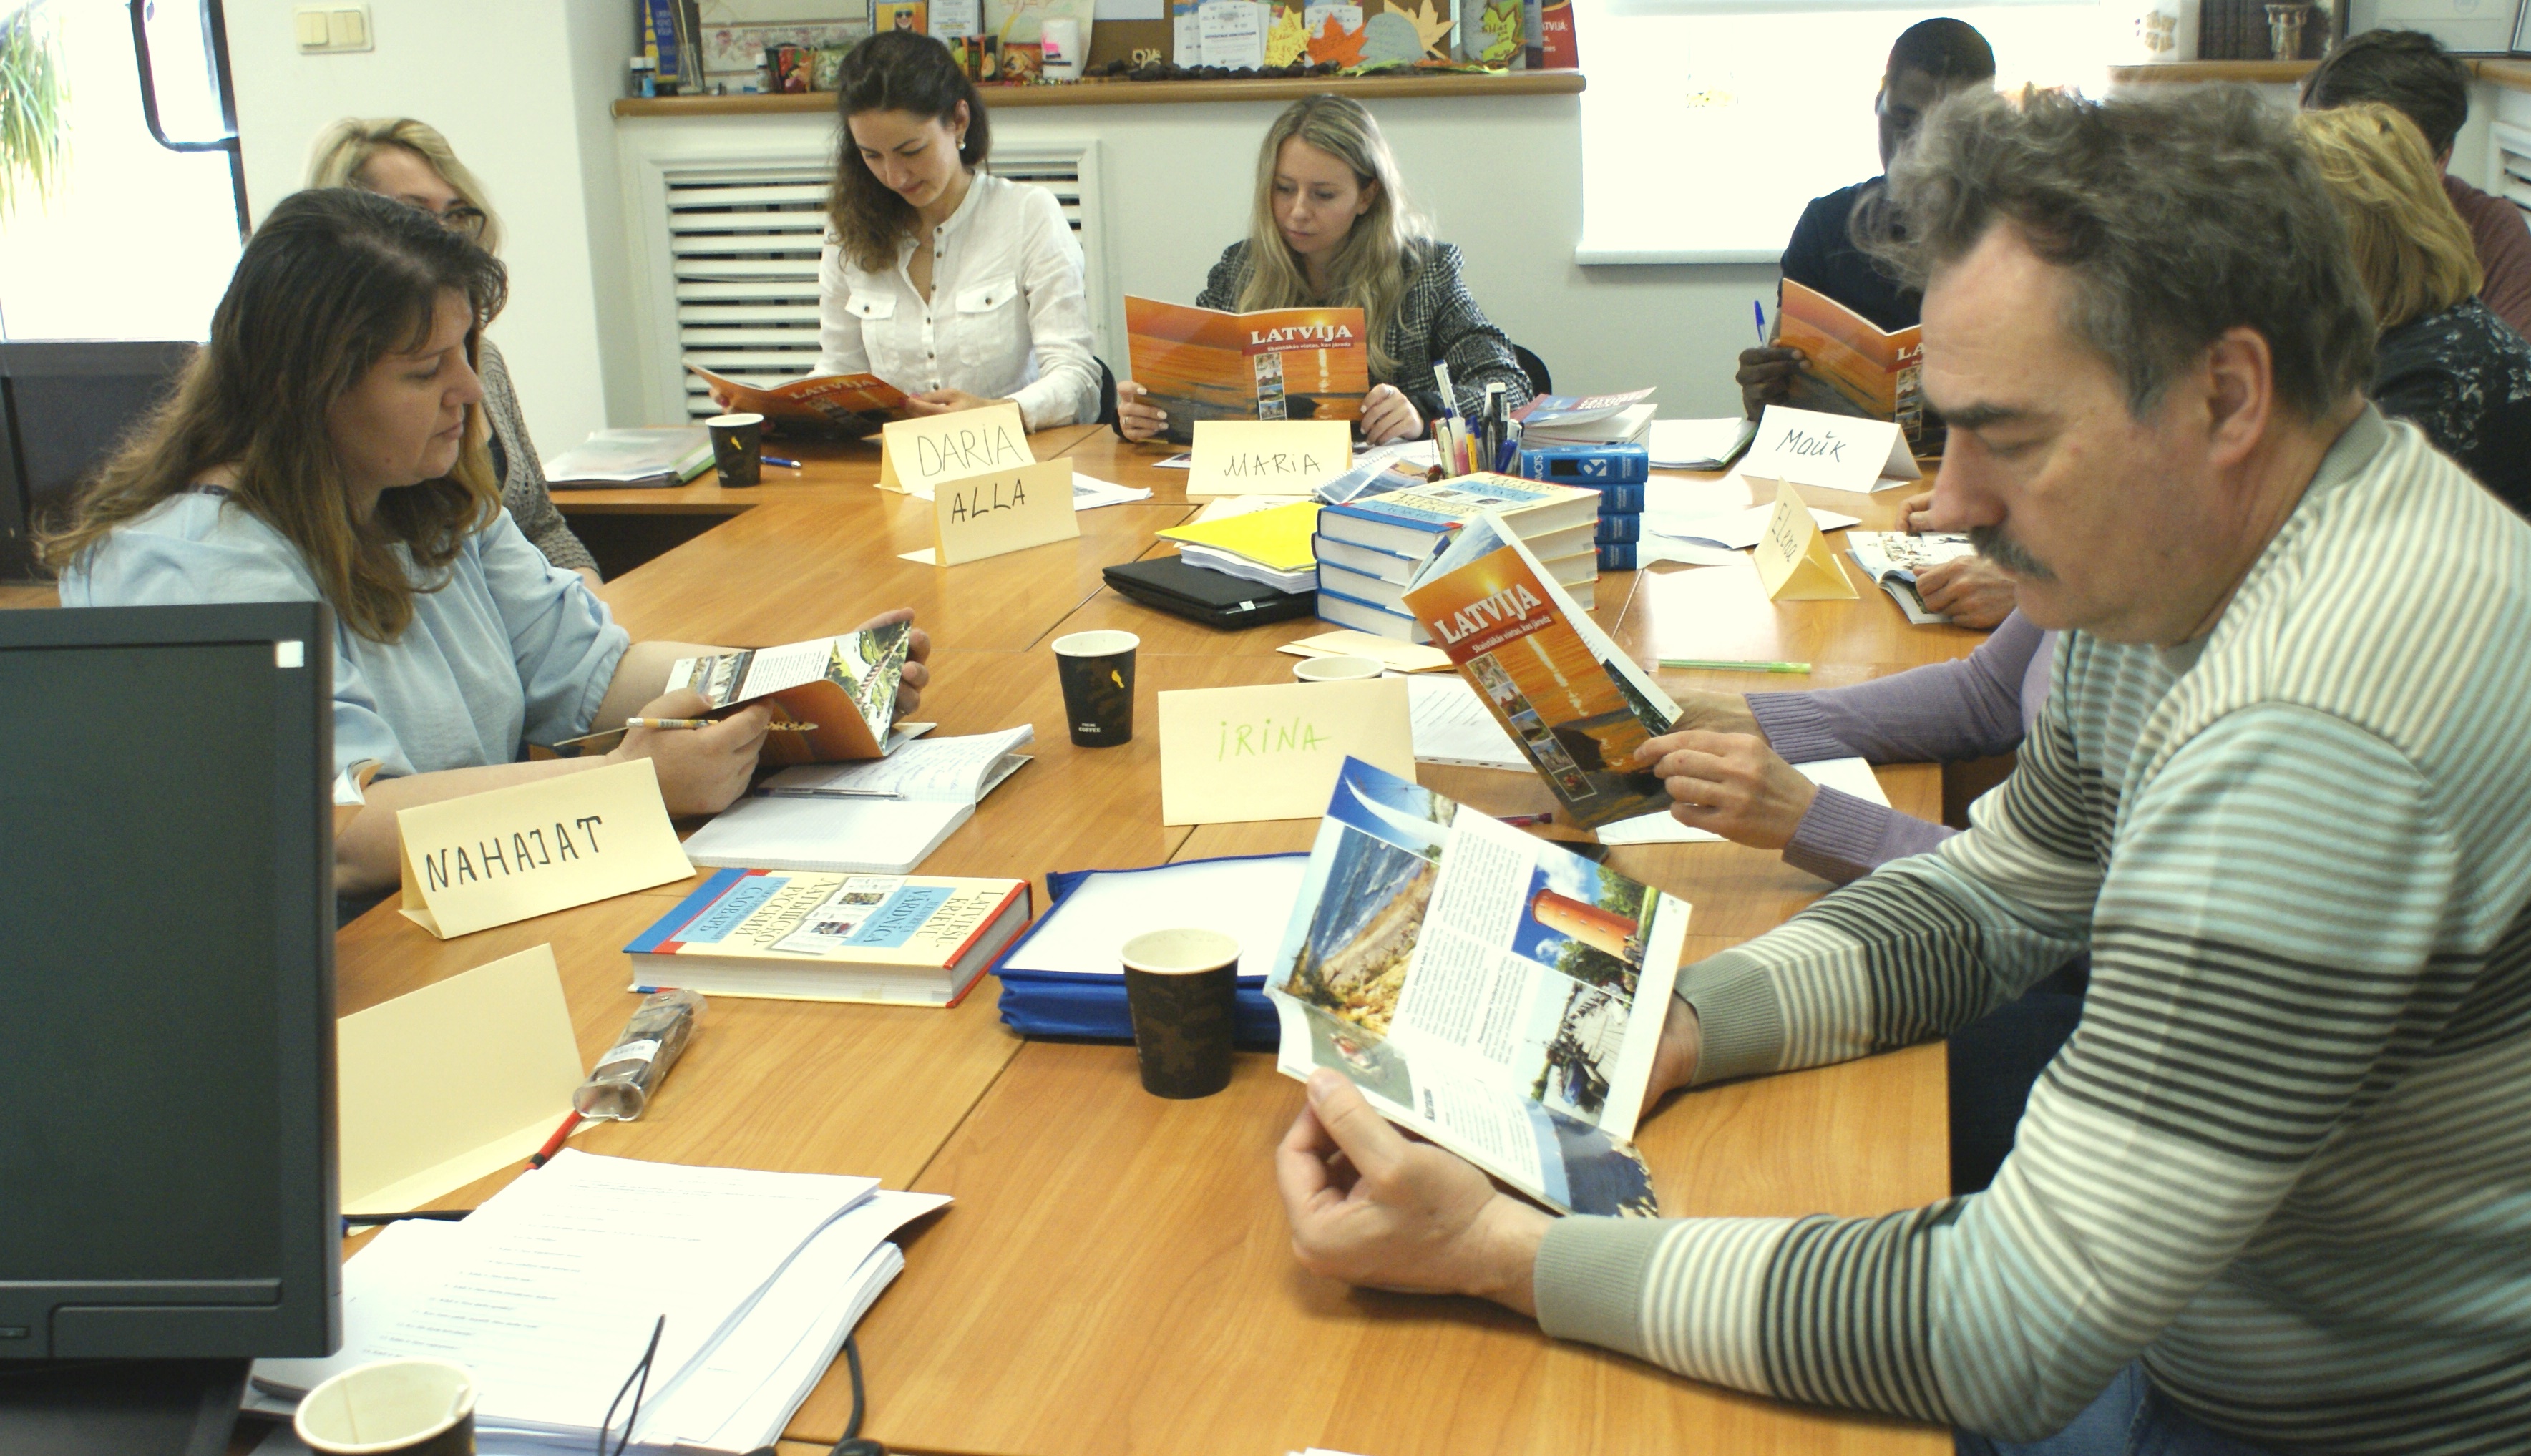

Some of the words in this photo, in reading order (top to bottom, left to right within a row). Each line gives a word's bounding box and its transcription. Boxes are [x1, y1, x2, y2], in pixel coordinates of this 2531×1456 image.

[1250, 324, 1353, 344] LATVIJA
[1897, 342, 1924, 361] LA
[789, 379, 877, 399] LATVIJA
[1776, 428, 1847, 463] Майк
[950, 479, 1026, 524] ALLA
[1434, 584, 1541, 644] LATVIJA
[1520, 620, 1533, 632] kas
[425, 815, 603, 892] NAHAJAT
[696, 886, 766, 932] СЛОВАРЬ
[733, 886, 809, 935] РУССКИЙ
[862, 889, 937, 943] VĀRDNĪCA
[912, 897, 970, 938] KRIEVU
